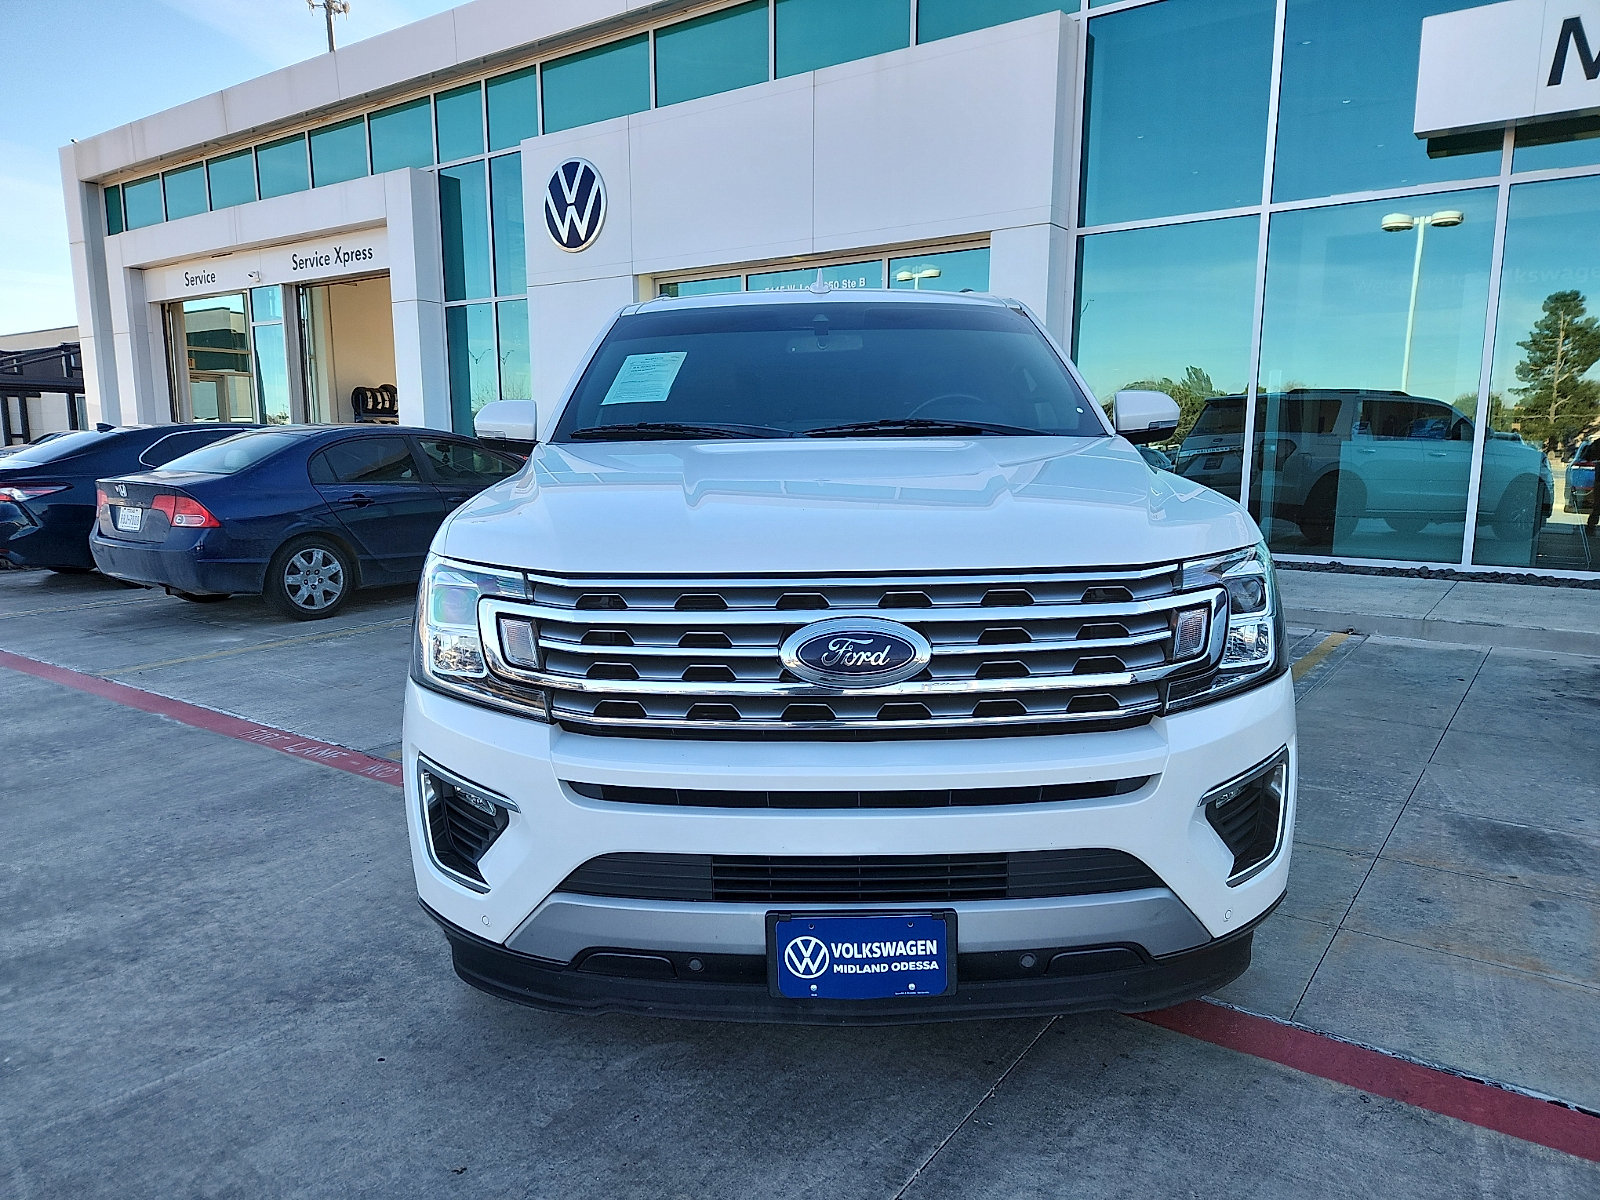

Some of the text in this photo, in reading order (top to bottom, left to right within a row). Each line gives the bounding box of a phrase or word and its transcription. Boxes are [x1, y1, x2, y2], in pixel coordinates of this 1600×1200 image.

[291, 245, 374, 271] Service Xpress
[184, 269, 216, 287] Service
[842, 279, 857, 288] Ste
[859, 277, 866, 287] B
[821, 637, 892, 667] Ford
[831, 939, 938, 959] VOLKSWAGEN
[833, 960, 939, 974] MIDLAND ODESSA
